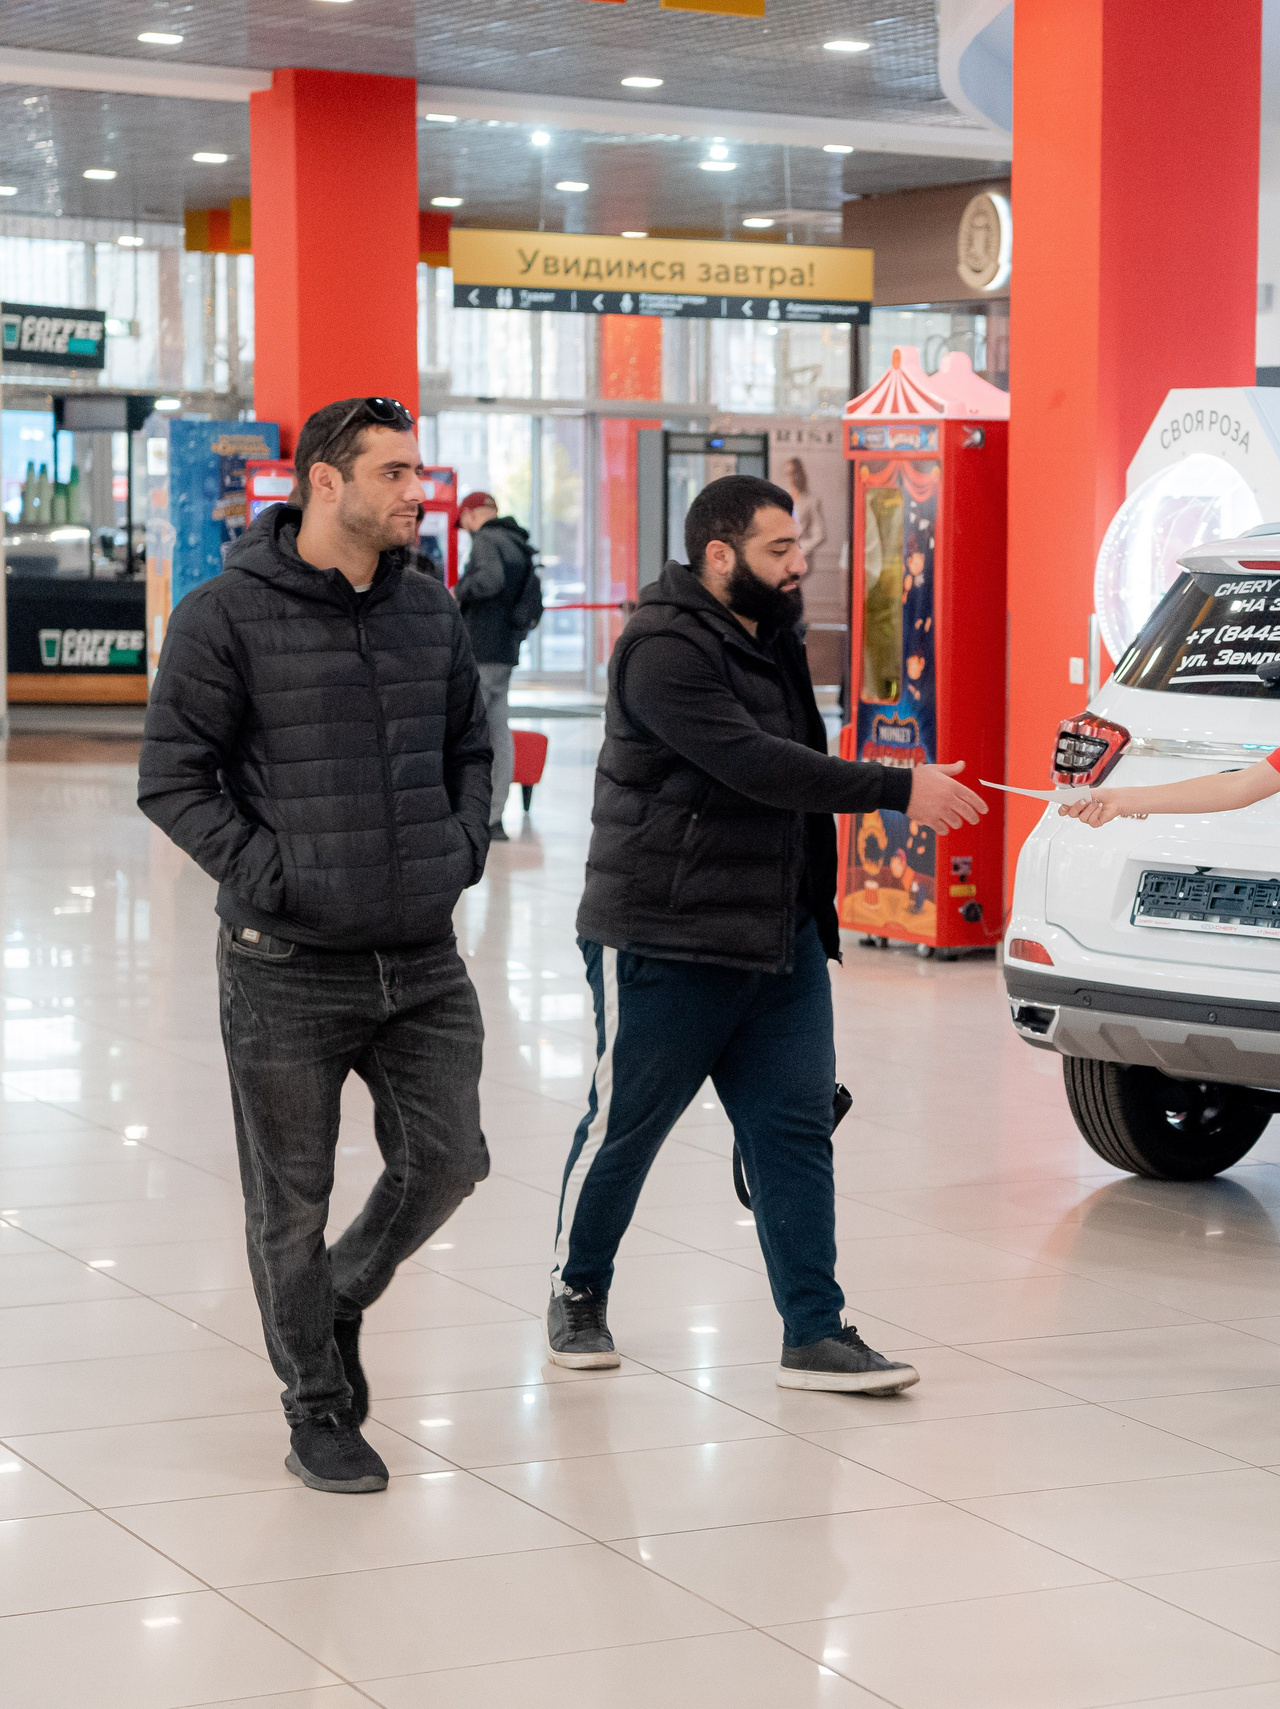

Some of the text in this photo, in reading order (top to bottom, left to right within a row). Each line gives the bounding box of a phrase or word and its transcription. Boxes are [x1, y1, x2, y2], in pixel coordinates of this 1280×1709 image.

[517, 248, 815, 290] Увидимся завтра!
[23, 315, 103, 340] COFFEE
[1161, 410, 1250, 453] СВОЯ РОЗА
[1214, 579, 1280, 597] CHERY
[1238, 600, 1266, 614] НА
[62, 629, 145, 650] COFFEE
[1186, 627, 1215, 645] +7
[61, 645, 110, 666] LIKE
[1176, 652, 1208, 672] ул.
